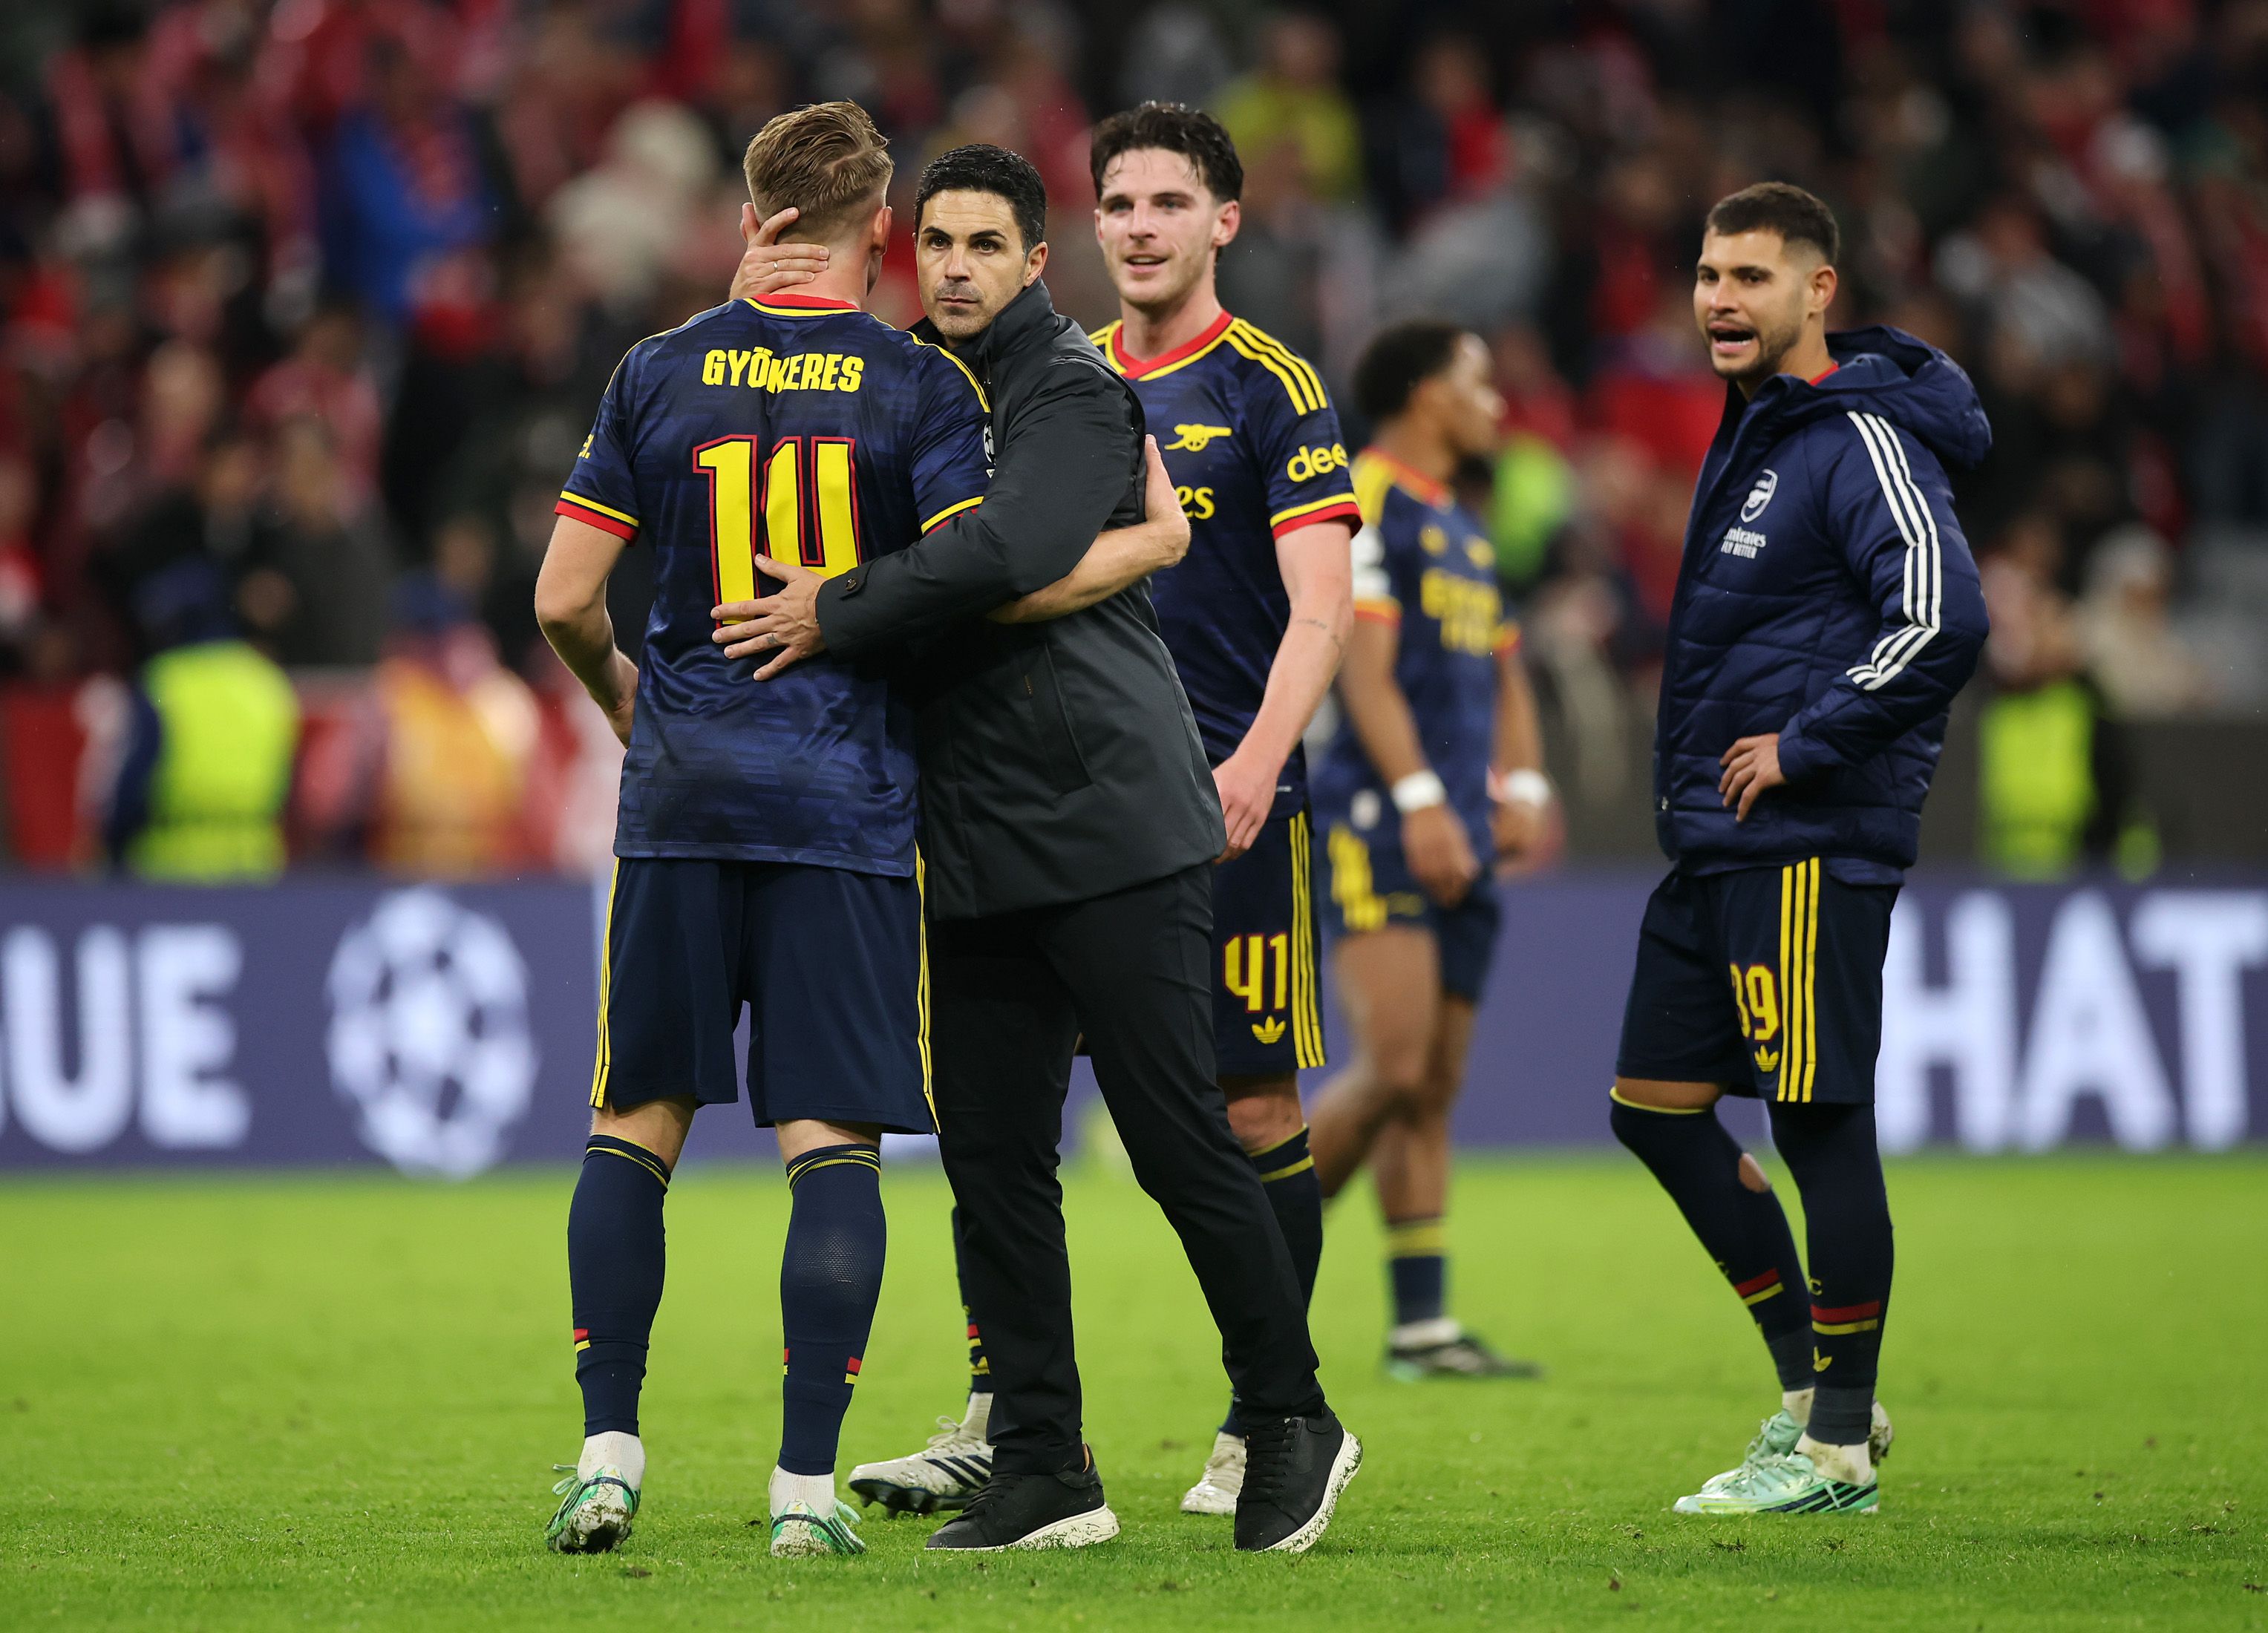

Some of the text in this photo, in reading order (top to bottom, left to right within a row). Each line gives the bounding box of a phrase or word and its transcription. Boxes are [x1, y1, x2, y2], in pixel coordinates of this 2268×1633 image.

[702, 346, 865, 394] GYÖKERES
[693, 433, 862, 629] 14
[1223, 932, 1289, 1013] 41
